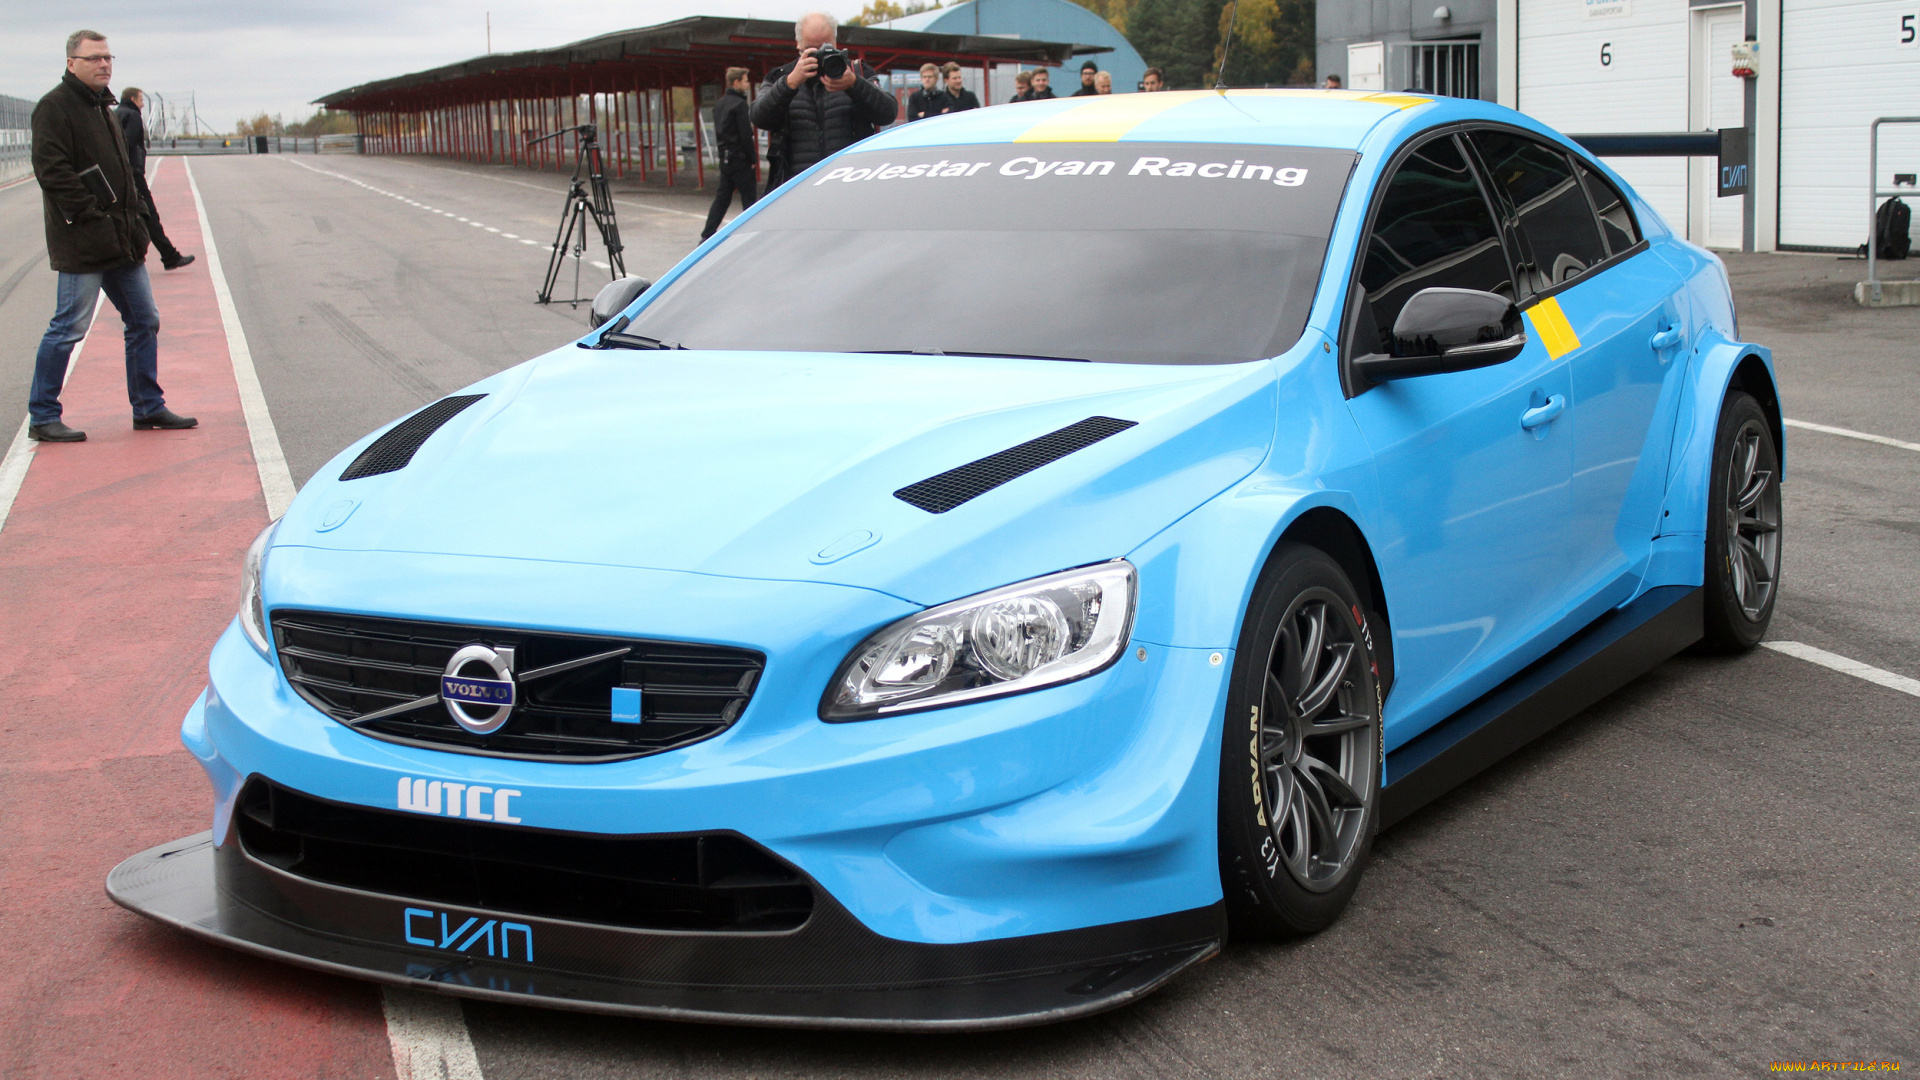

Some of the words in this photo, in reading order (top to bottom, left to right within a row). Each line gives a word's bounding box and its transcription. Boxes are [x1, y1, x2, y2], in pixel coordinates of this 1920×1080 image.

[1901, 14, 1916, 44] 5
[1600, 42, 1612, 66] 6
[812, 160, 992, 187] Polestar
[999, 156, 1116, 180] Cyan
[1127, 156, 1309, 187] Racing
[1722, 164, 1748, 189] CYAN
[445, 681, 508, 699] VOLVO
[1250, 705, 1267, 827] ADVAN
[397, 776, 522, 824] WTCC
[404, 907, 534, 962] CYAN
